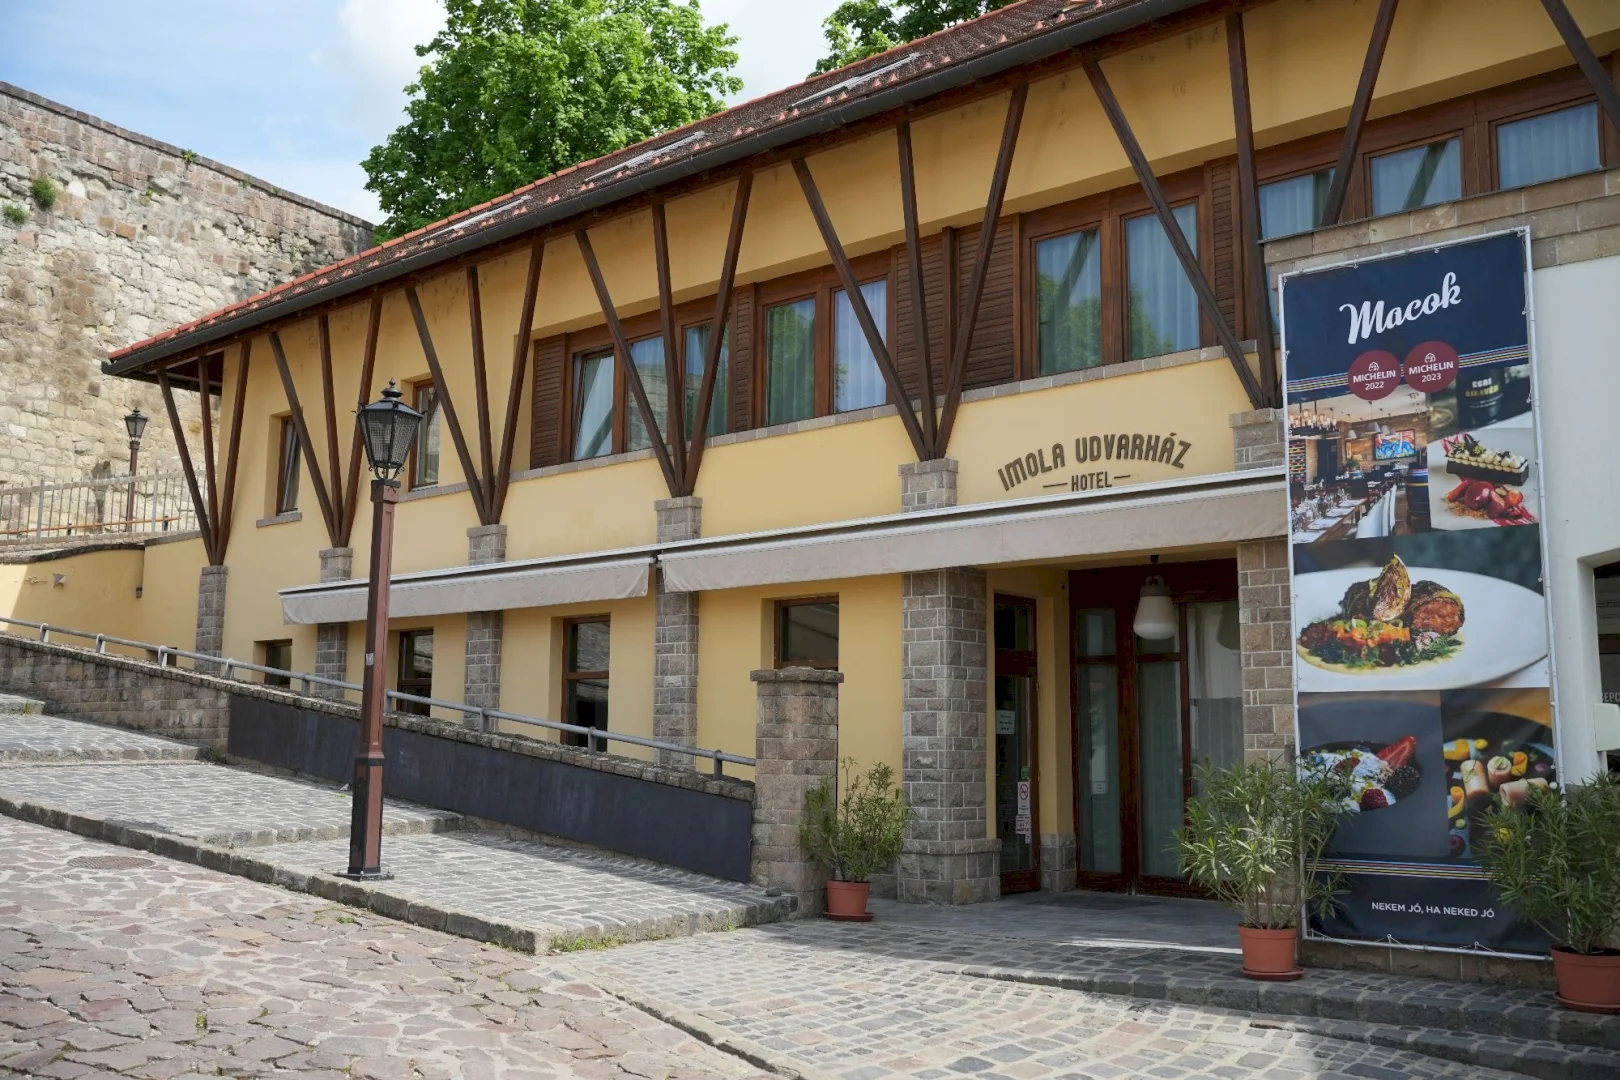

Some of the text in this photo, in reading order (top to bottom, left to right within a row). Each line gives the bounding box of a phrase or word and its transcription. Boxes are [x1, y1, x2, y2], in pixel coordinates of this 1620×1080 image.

[1339, 271, 1462, 345] Macok
[1409, 361, 1454, 375] MICHELIN
[1353, 370, 1396, 383] MICHELIN
[1421, 373, 1442, 383] 2023
[1365, 381, 1385, 391] 2022
[997, 432, 1192, 492] IMOLA UDVARHÁZ
[1071, 471, 1113, 492] HOTEL
[1371, 902, 1495, 918] NEKEM JÓ, HA NEKED JÓ
